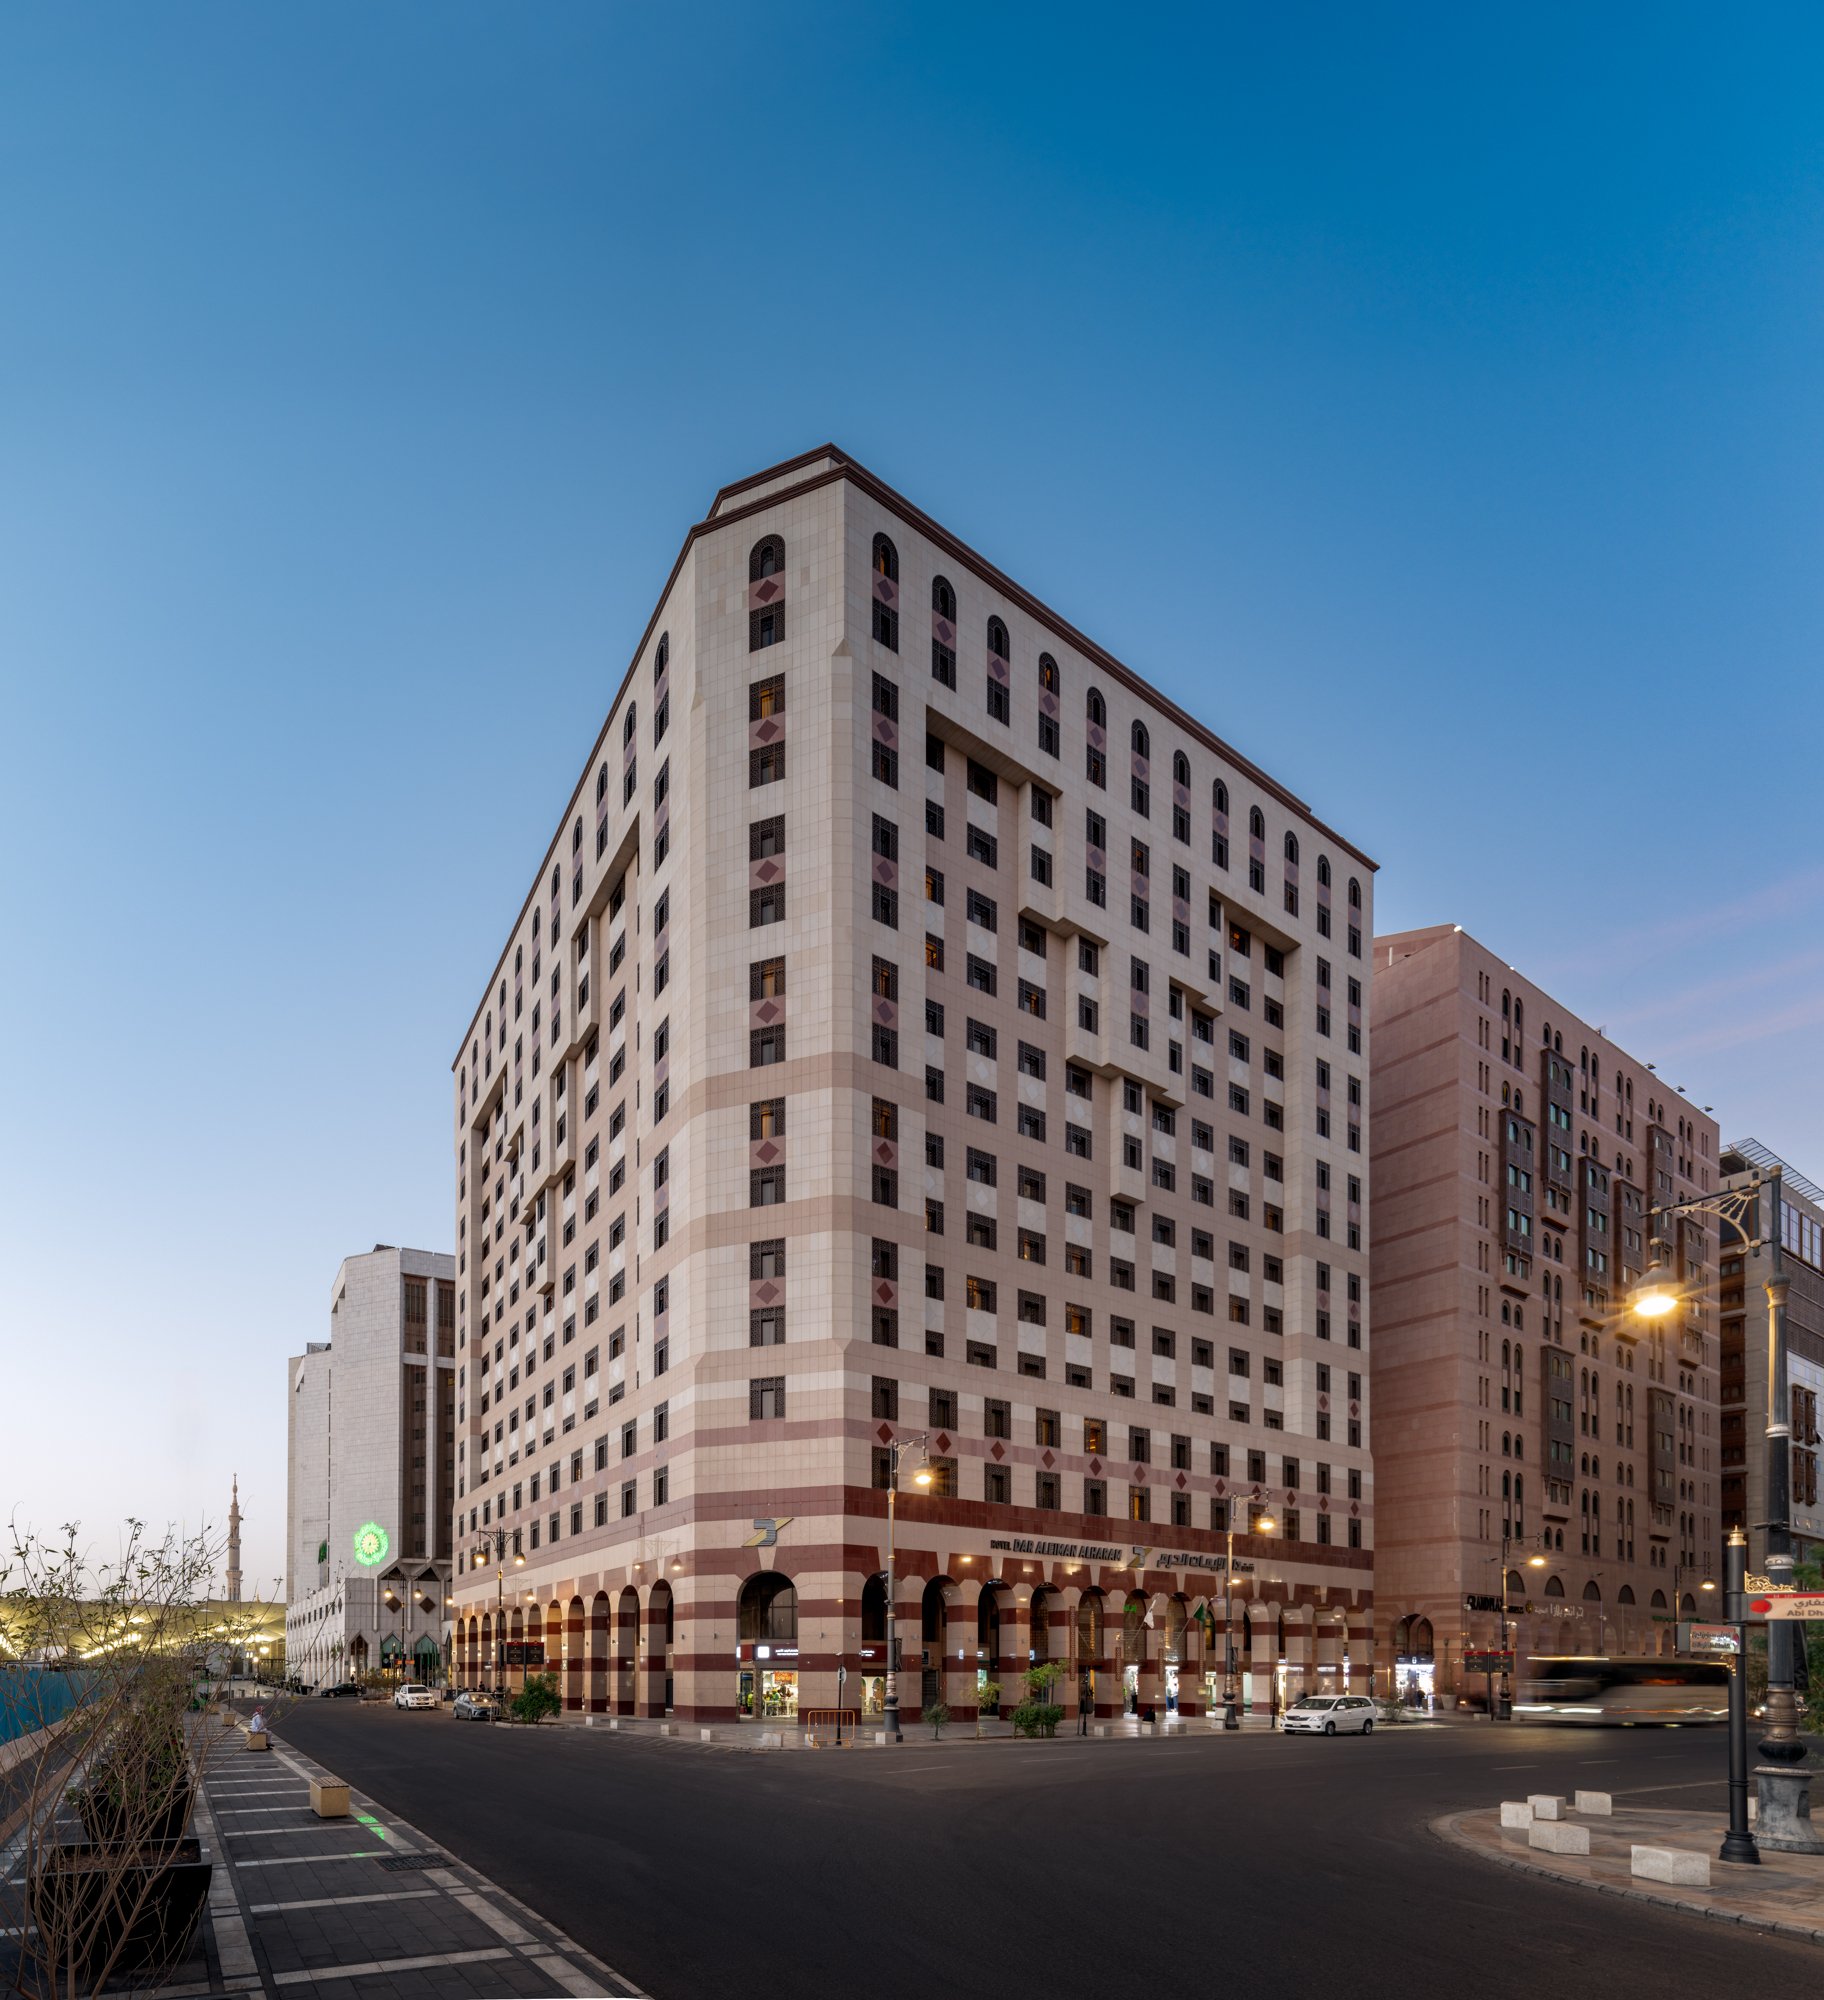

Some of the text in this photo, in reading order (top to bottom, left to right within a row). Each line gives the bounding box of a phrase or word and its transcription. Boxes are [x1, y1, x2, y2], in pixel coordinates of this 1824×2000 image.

[1013, 1539, 1034, 1553] DAR
[1035, 1541, 1077, 1557] ALEIMAN
[1078, 1545, 1121, 1561] ALHARAM
[1787, 1609, 1824, 1617] Abi Dh
